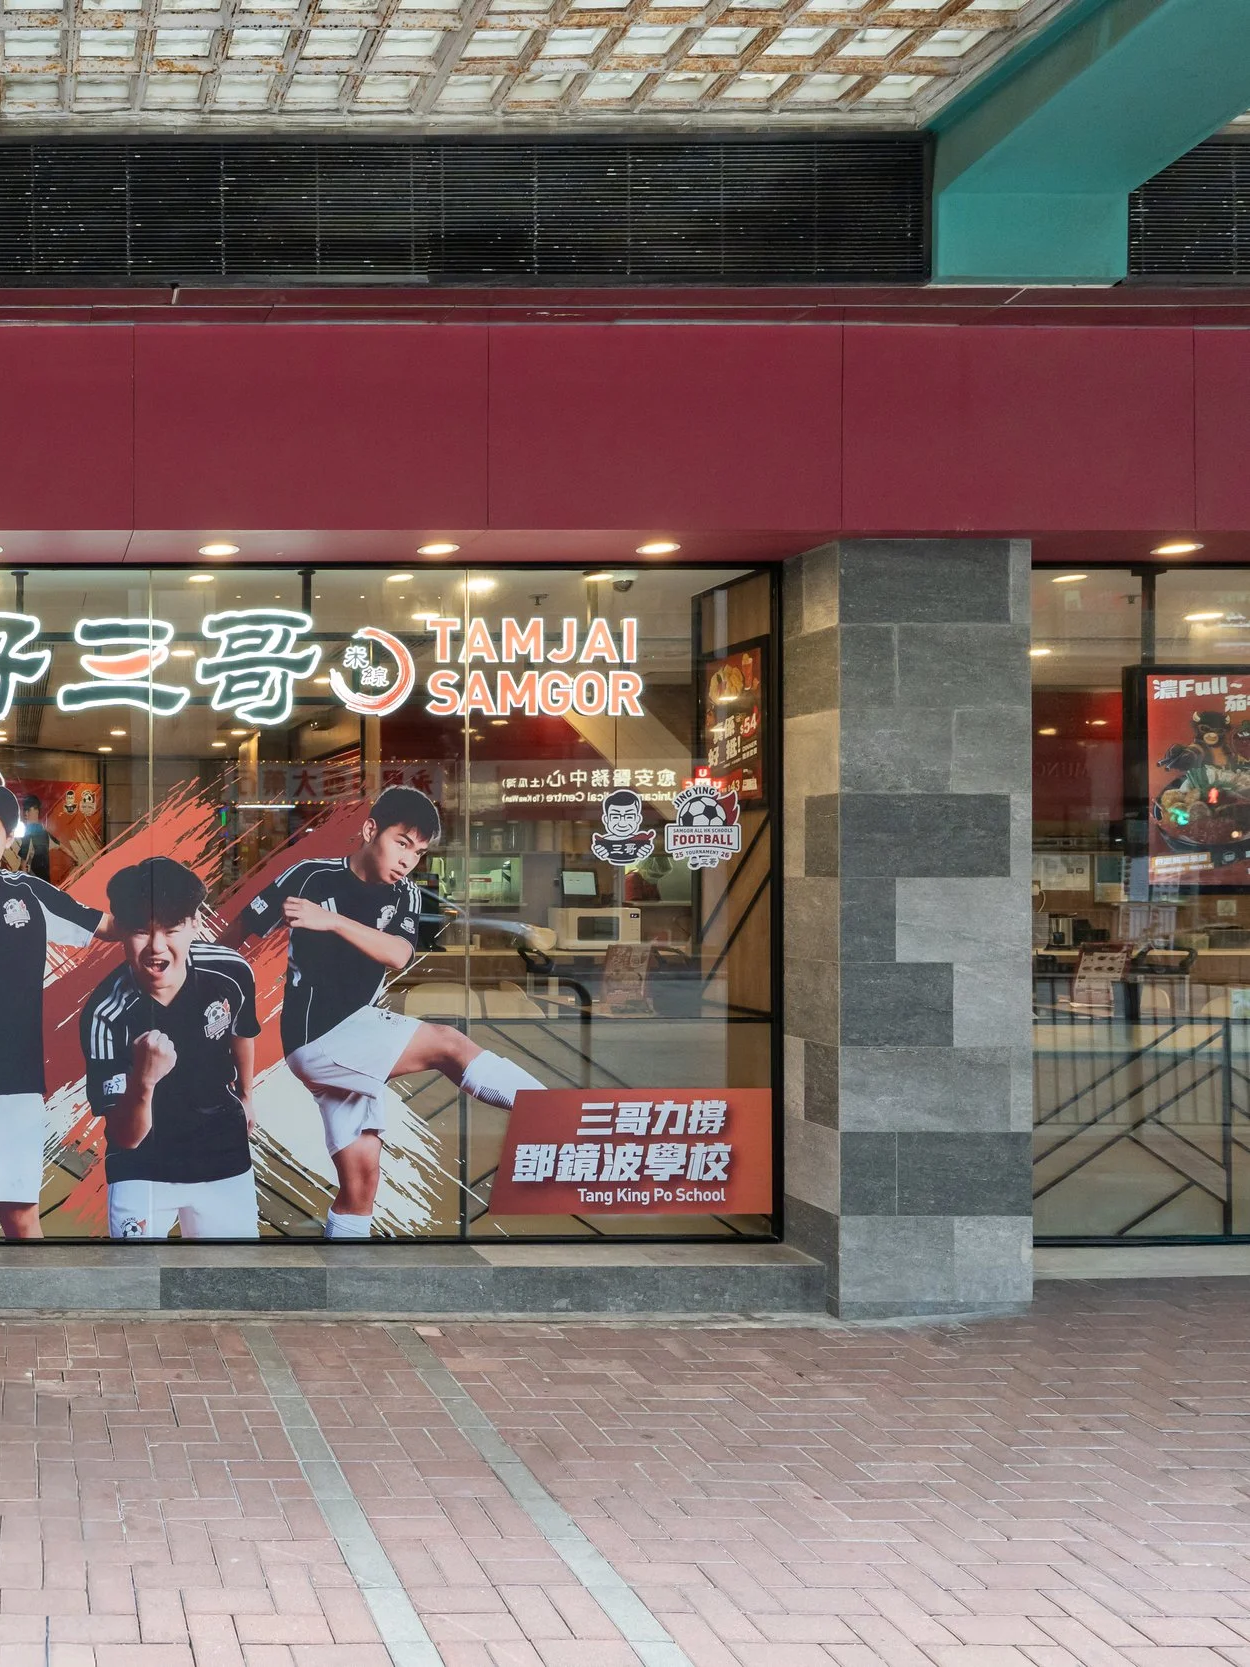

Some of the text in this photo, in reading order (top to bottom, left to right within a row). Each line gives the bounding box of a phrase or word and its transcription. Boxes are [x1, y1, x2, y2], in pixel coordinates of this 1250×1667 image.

[426, 617, 638, 663] TAMJAI
[343, 646, 390, 688] 米線
[425, 669, 644, 716] SAMGOR
[1225, 694, 1250, 712] 茄
[674, 786, 715, 808] JING YING
[673, 834, 733, 846] FOOTBALL
[512, 1142, 732, 1182] 鄧鏡波學校
[577, 1187, 725, 1205] Tang King Po School
